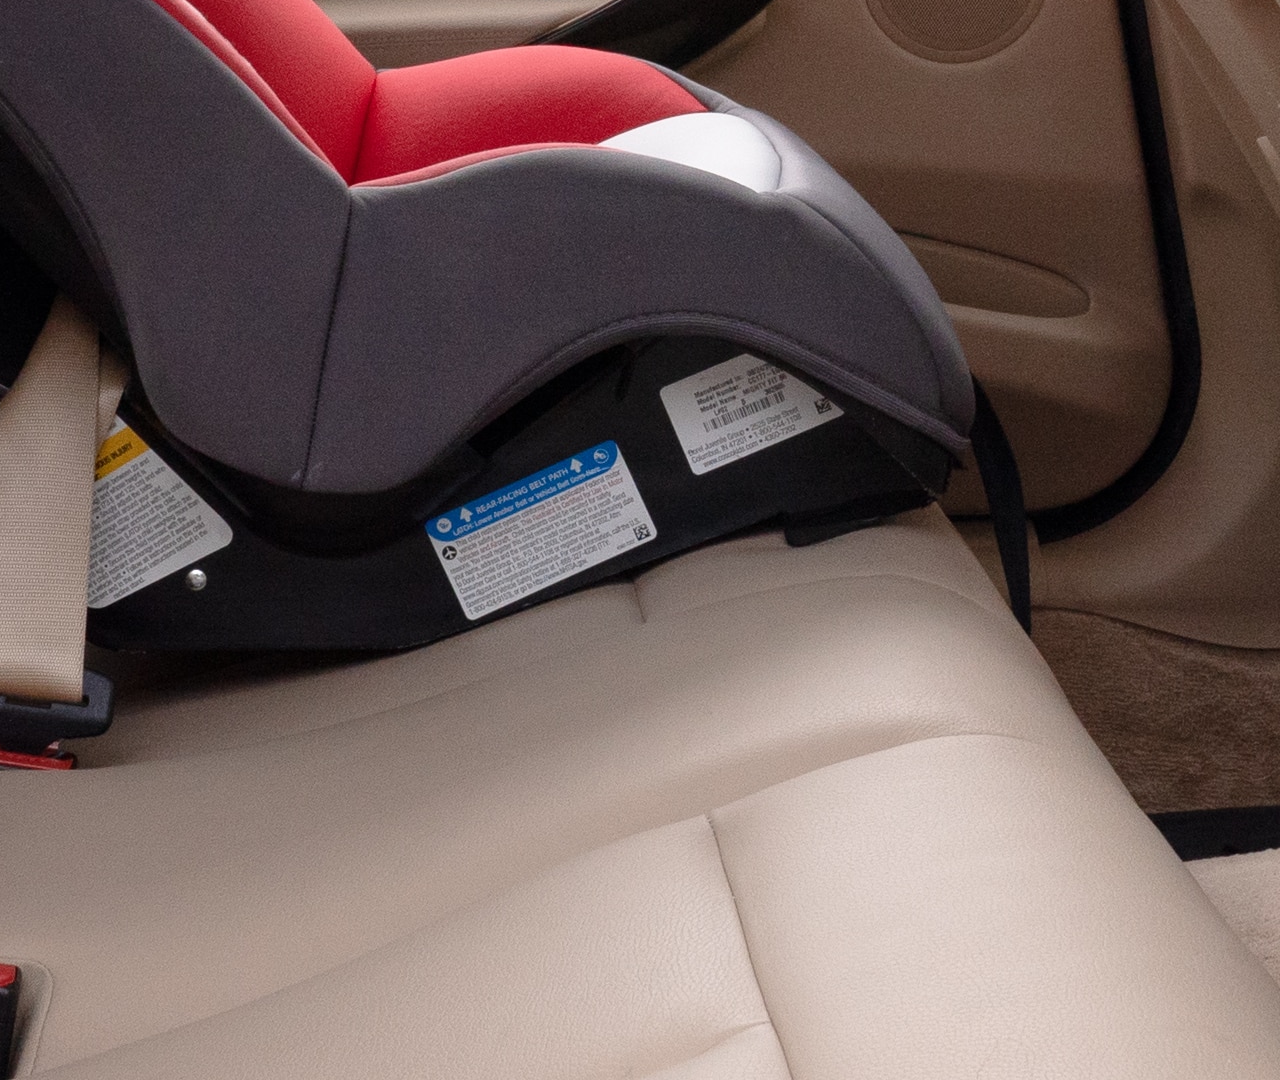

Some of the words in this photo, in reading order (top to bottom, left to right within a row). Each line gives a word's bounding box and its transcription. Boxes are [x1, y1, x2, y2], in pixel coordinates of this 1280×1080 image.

[697, 394, 716, 406] Model
[700, 402, 719, 413] Model
[704, 436, 727, 450] Juvenile
[727, 428, 745, 441] Group
[110, 443, 133, 460] INJURY
[475, 486, 528, 514] REAR-FACING
[529, 477, 548, 491] BELT
[548, 468, 569, 482] PATH
[474, 514, 493, 527] Lower
[493, 504, 515, 518] Anchor
[515, 498, 528, 509] Belt
[527, 495, 535, 503] or
[534, 485, 557, 500] Vehicle
[557, 480, 570, 490] Belt
